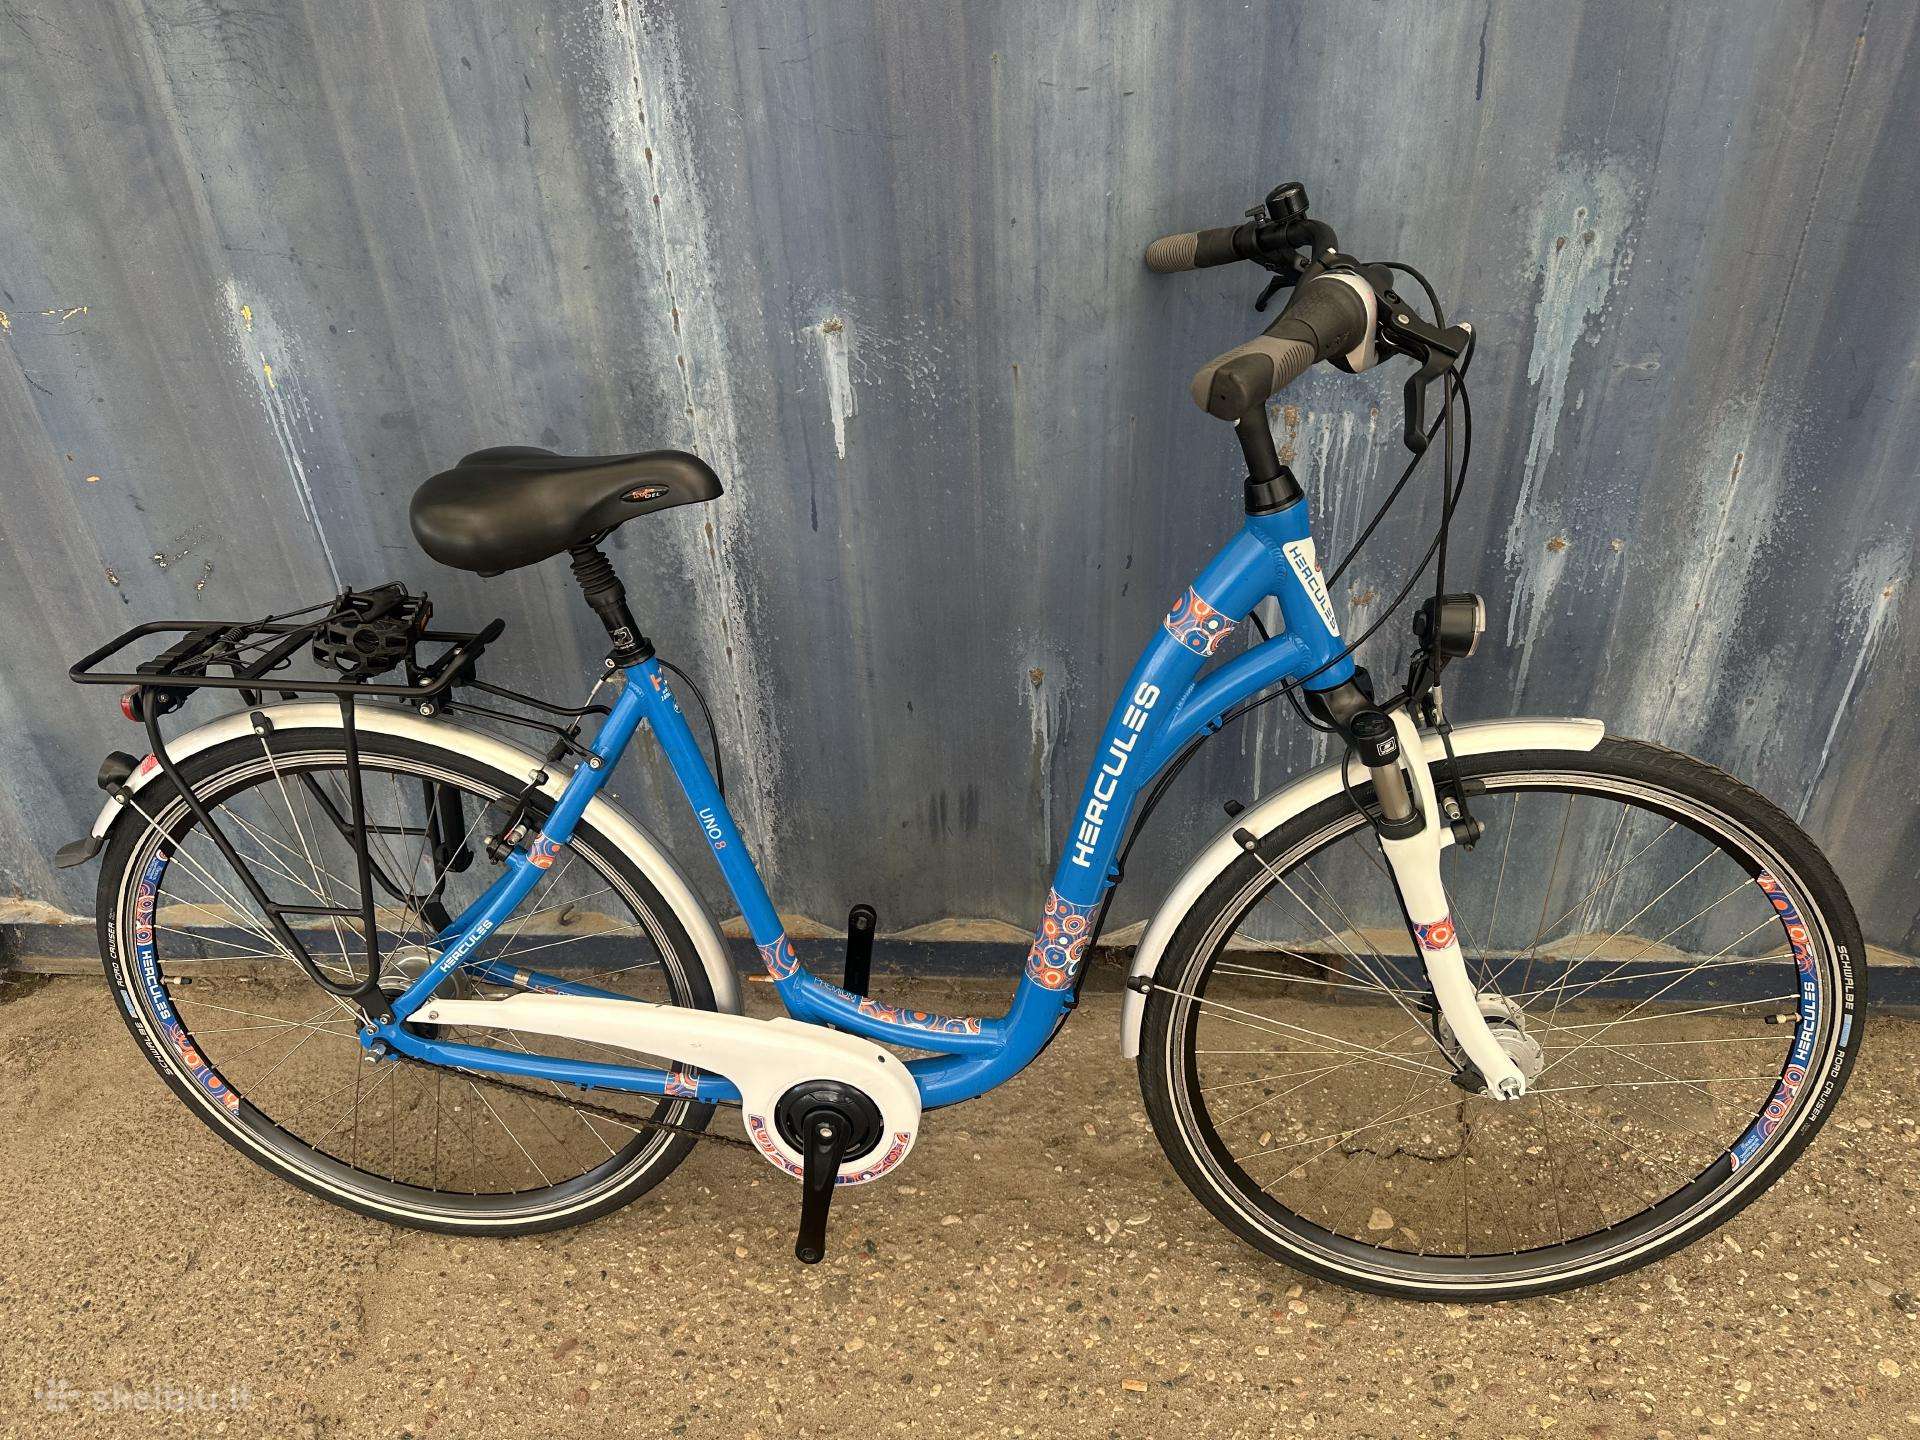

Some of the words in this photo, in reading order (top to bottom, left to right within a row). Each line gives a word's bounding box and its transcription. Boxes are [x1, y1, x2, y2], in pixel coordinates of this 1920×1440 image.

[1289, 546, 1336, 630] HERCULES
[1072, 681, 1161, 868] HERCULES
[699, 807, 722, 840] UNO
[714, 840, 727, 850] 8
[107, 921, 117, 959] CRUISER
[440, 919, 494, 973] HERCULES
[112, 962, 125, 987] ROAD
[141, 950, 171, 1020] HERCULES
[1837, 945, 1855, 1010] SCHWALBE
[1795, 981, 1816, 1060] HERCULES
[134, 1021, 174, 1075] SCHWALBE
[1830, 1049, 1846, 1078] ROAD
[1808, 1080, 1834, 1122] CRUISER
